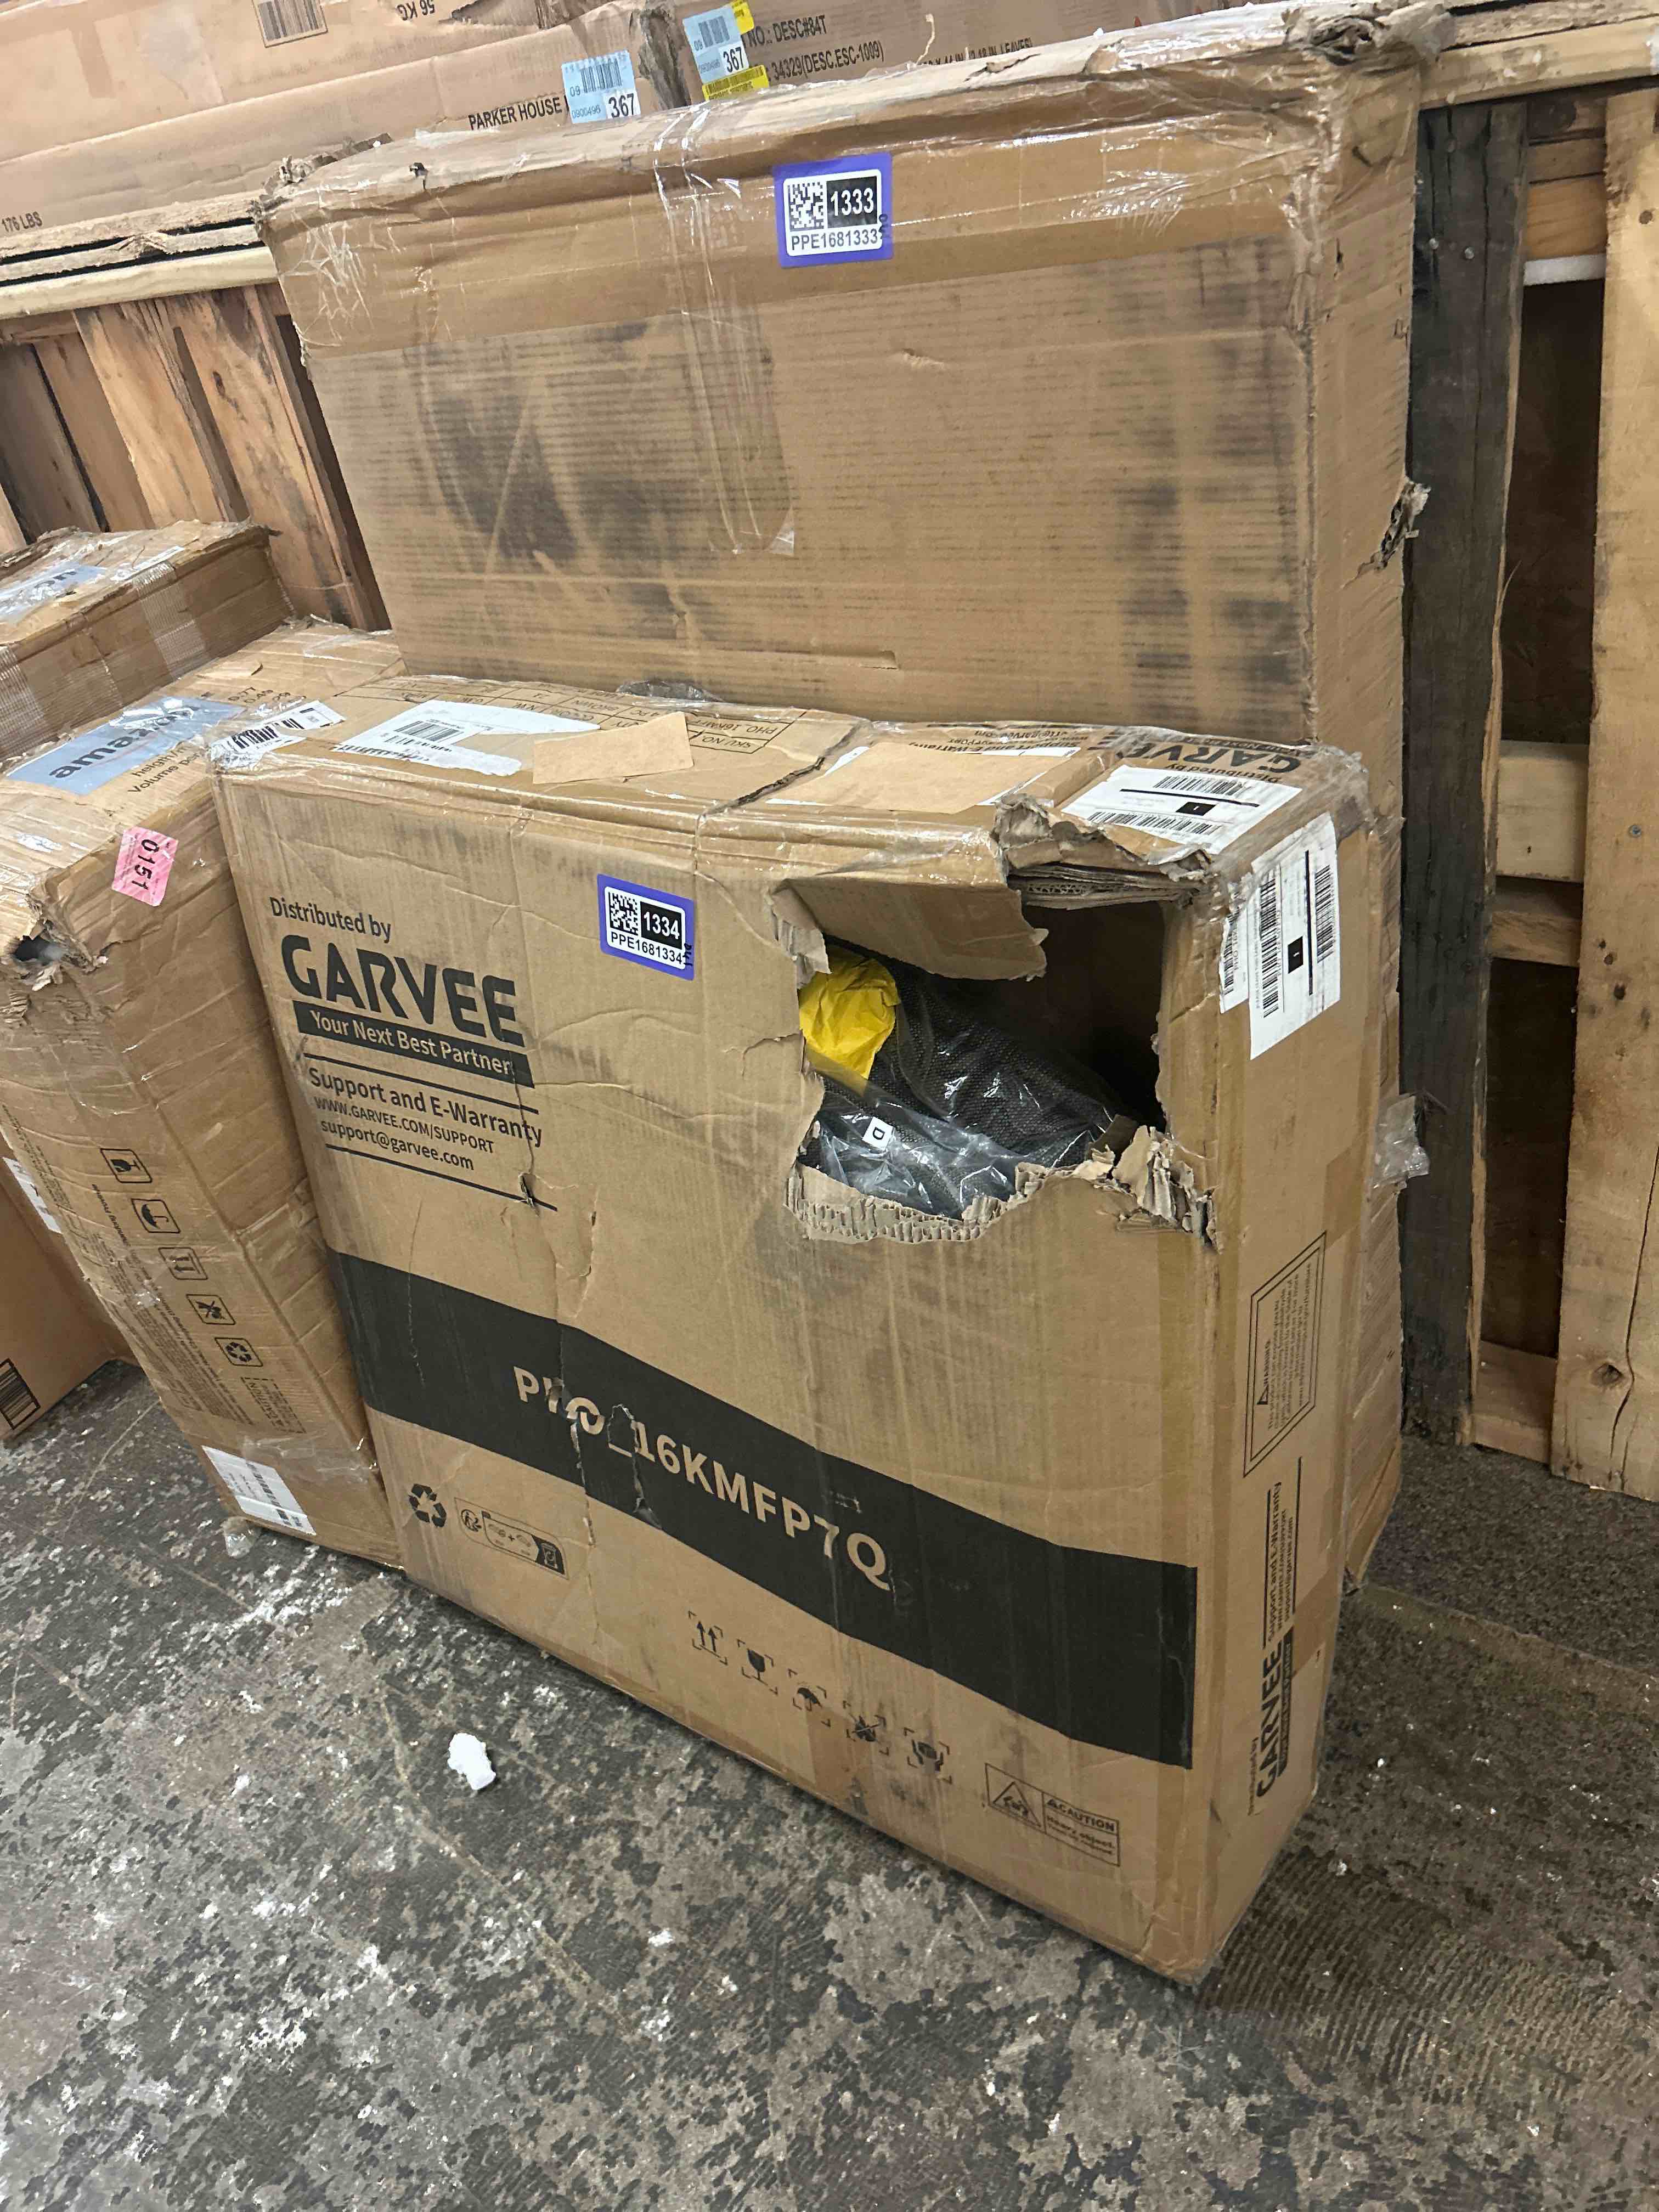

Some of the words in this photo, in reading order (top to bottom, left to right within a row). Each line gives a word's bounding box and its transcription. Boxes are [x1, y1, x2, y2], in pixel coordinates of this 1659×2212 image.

[397, 3, 417, 21] KG
[419, 0, 435, 15] 56
[772, 15, 827, 43] DESC#84T
[723, 46, 744, 72] 367
[772, 40, 884, 81] 34329(DESC.ESC-1009)
[569, 86, 581, 97] 09
[468, 106, 517, 131] PARKER
[517, 97, 563, 121] HOUSE
[608, 93, 635, 119] 367
[831, 187, 874, 216] 1333
[2, 216, 20, 233] 176
[20, 211, 42, 229] LBS
[791, 228, 878, 251] PPE1681333
[702, 735, 724, 745] NO.
[726, 741, 752, 749] SKU
[127, 765, 179, 793] Volume
[1164, 763, 1189, 772] by
[1192, 767, 1281, 783] Distributed
[131, 839, 159, 890] 0151
[269, 896, 365, 934] Distributed
[368, 914, 391, 943] by
[643, 911, 680, 940] 1334
[611, 930, 682, 964] PPE1681334
[281, 934, 526, 1048] GARVEE
[309, 1009, 349, 1035] Your
[352, 1022, 394, 1046] Next
[396, 1030, 438, 1058] Best
[439, 1041, 515, 1076] Partner
[308, 1067, 386, 1103] Support
[390, 1091, 426, 1113] and
[430, 1097, 542, 1148] E-Warranty
[314, 1097, 494, 1154] WWW.GARVEE.COM/SUPPORT
[872, 1126, 885, 1140] D
[321, 1119, 474, 1170] support@garvee.com
[1256, 1640, 1283, 1797] GARVEE
[1059, 1804, 1115, 1832] CAUTION
